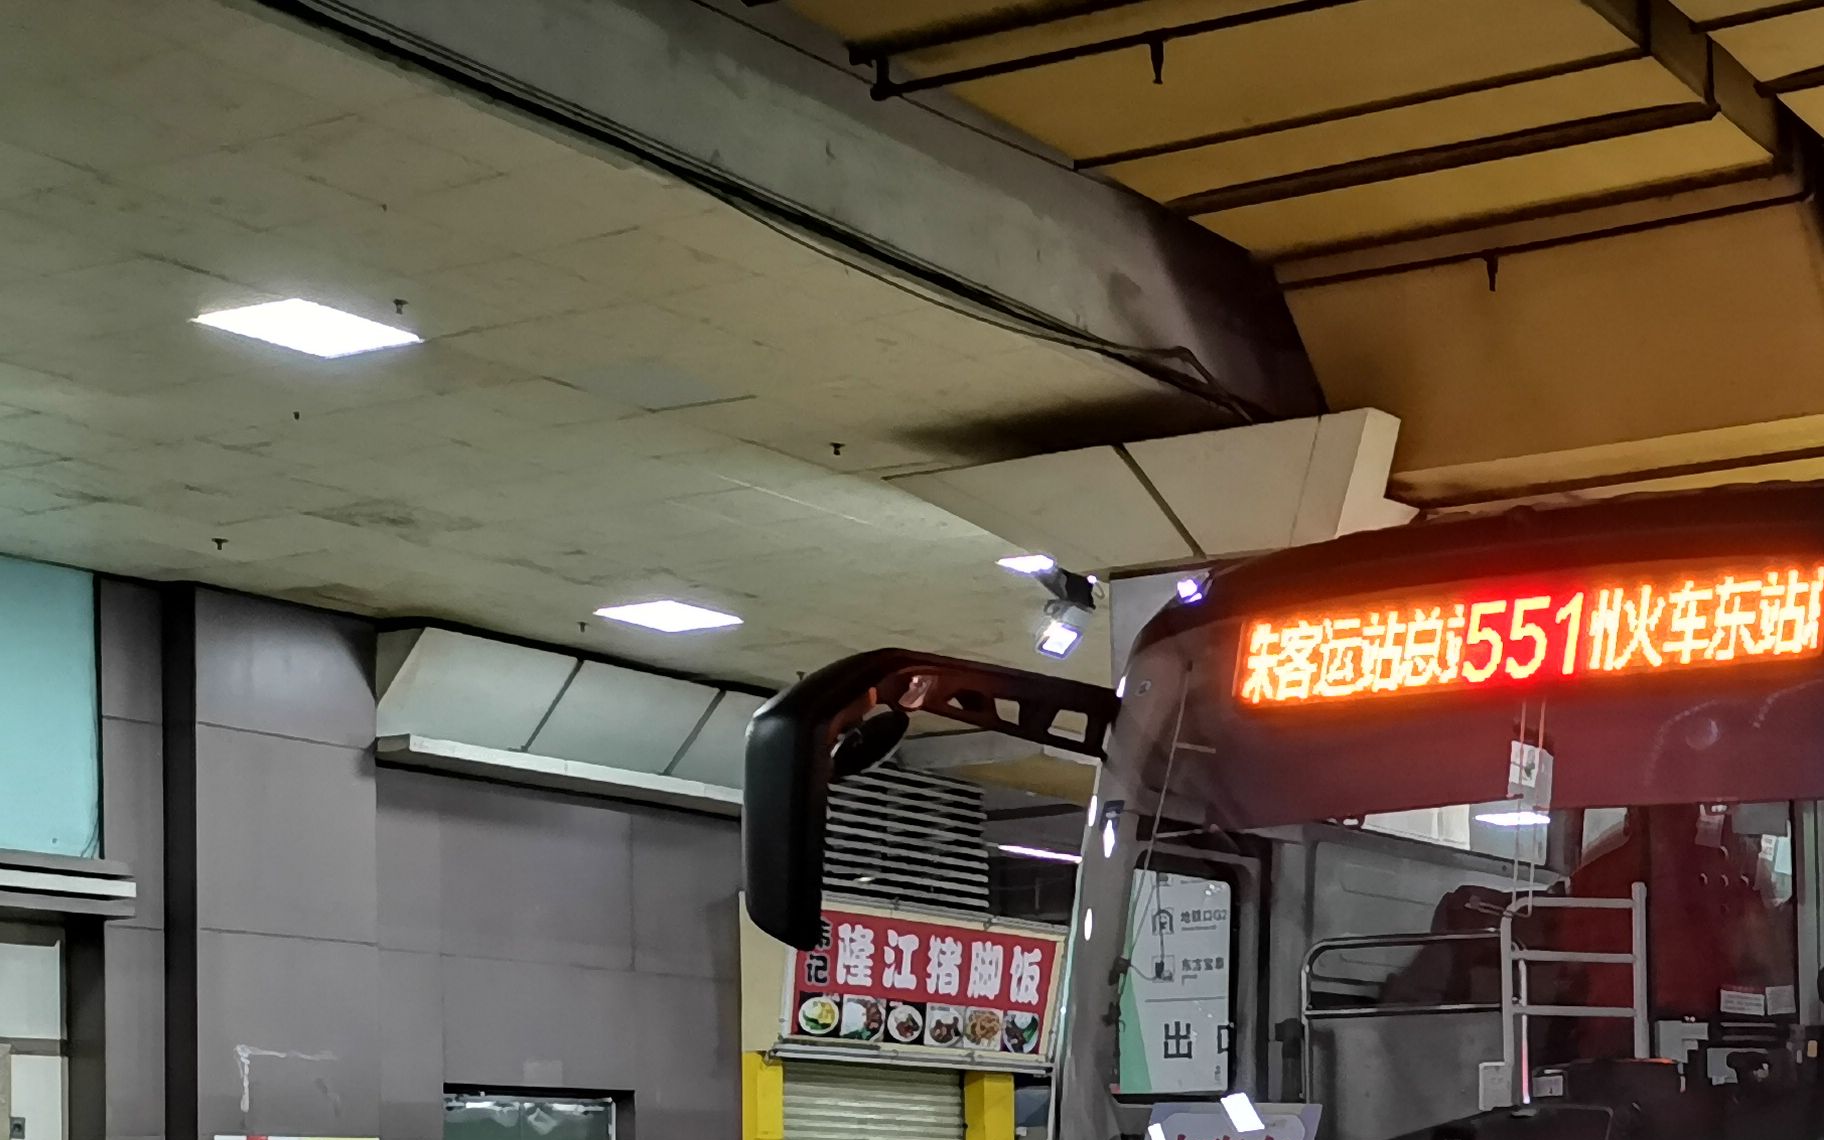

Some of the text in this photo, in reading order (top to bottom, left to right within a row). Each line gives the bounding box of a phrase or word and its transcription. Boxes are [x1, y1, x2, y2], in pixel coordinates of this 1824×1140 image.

[1462, 591, 1585, 683] 551
[836, 922, 1042, 1005] 隆江猪脚饭
